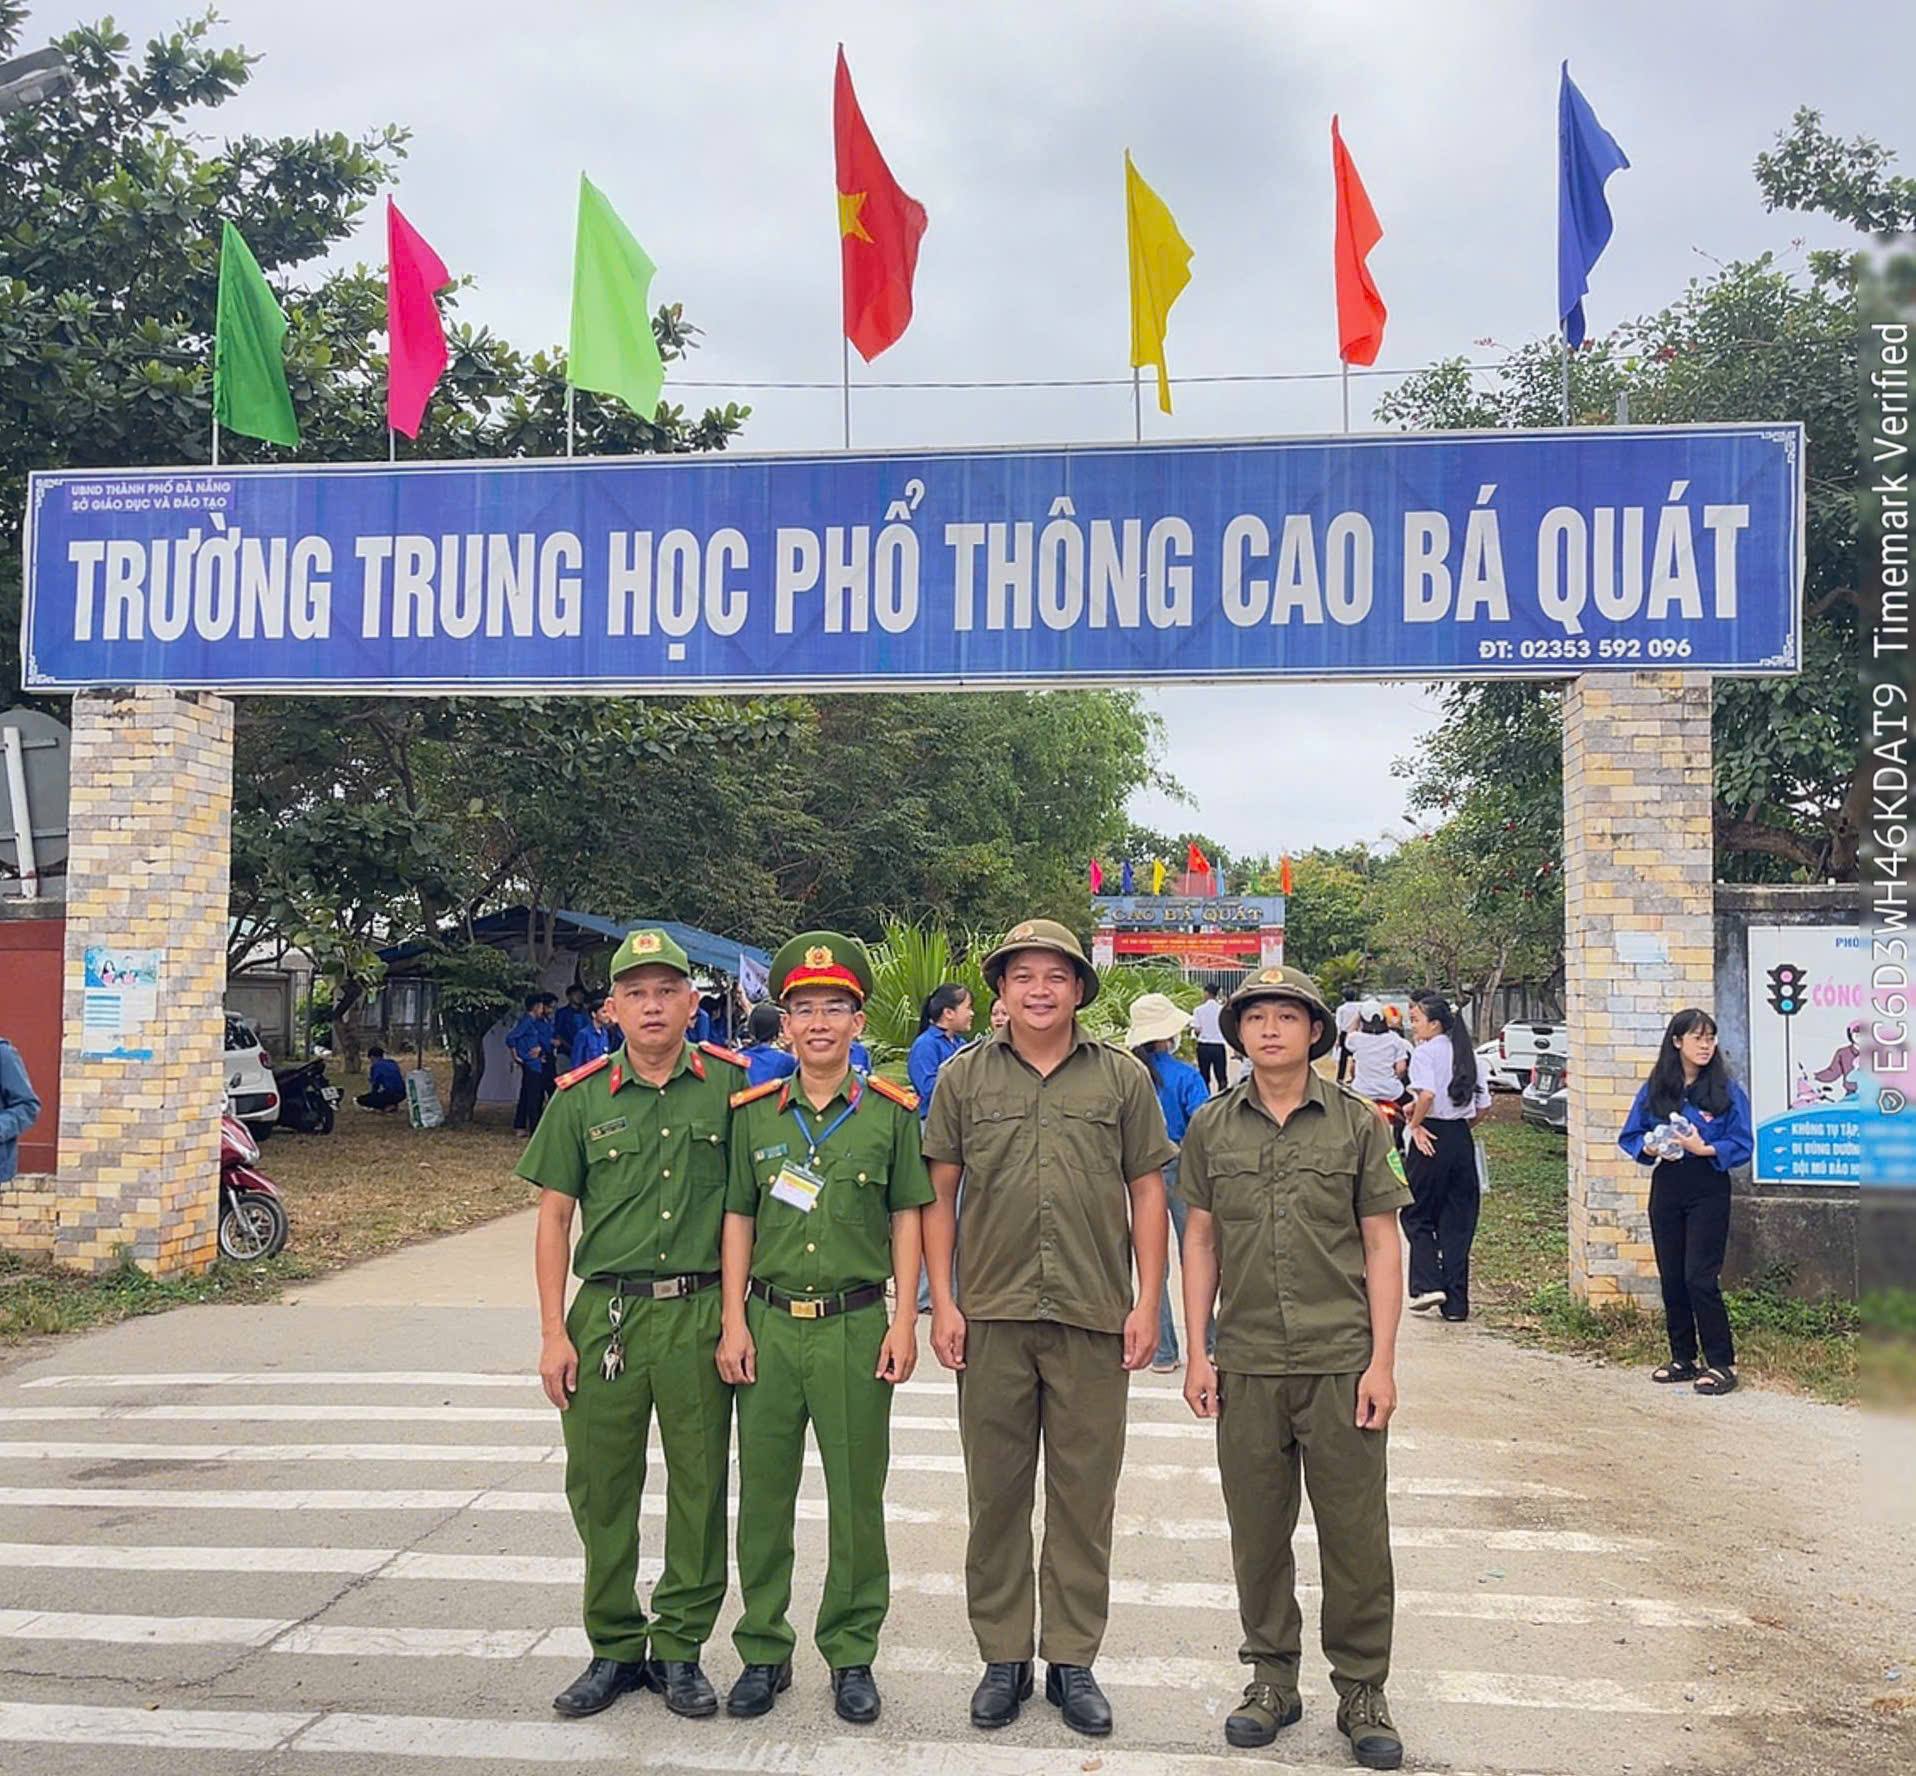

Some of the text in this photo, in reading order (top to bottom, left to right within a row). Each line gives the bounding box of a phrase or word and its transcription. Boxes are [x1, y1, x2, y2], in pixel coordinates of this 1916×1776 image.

[72, 484, 102, 496] UBND
[106, 482, 145, 495] THÀNH
[147, 480, 174, 494] PHỐ
[175, 480, 193, 493] ĐÀ
[72, 497, 89, 511] SỞ
[91, 496, 123, 510] GIÁO
[125, 498, 151, 511] DỤC
[153, 495, 170, 509] VÀ
[202, 497, 228, 510] TẠO
[68, 478, 1750, 661] TRƯỜNG TRUNG HỌC PHỔ THÔNG CAO BÁ QUÁT
[1479, 638, 1692, 659] ĐT: 02353 592 096
[1111, 905, 1264, 922] CAO BÁ QUÁT
